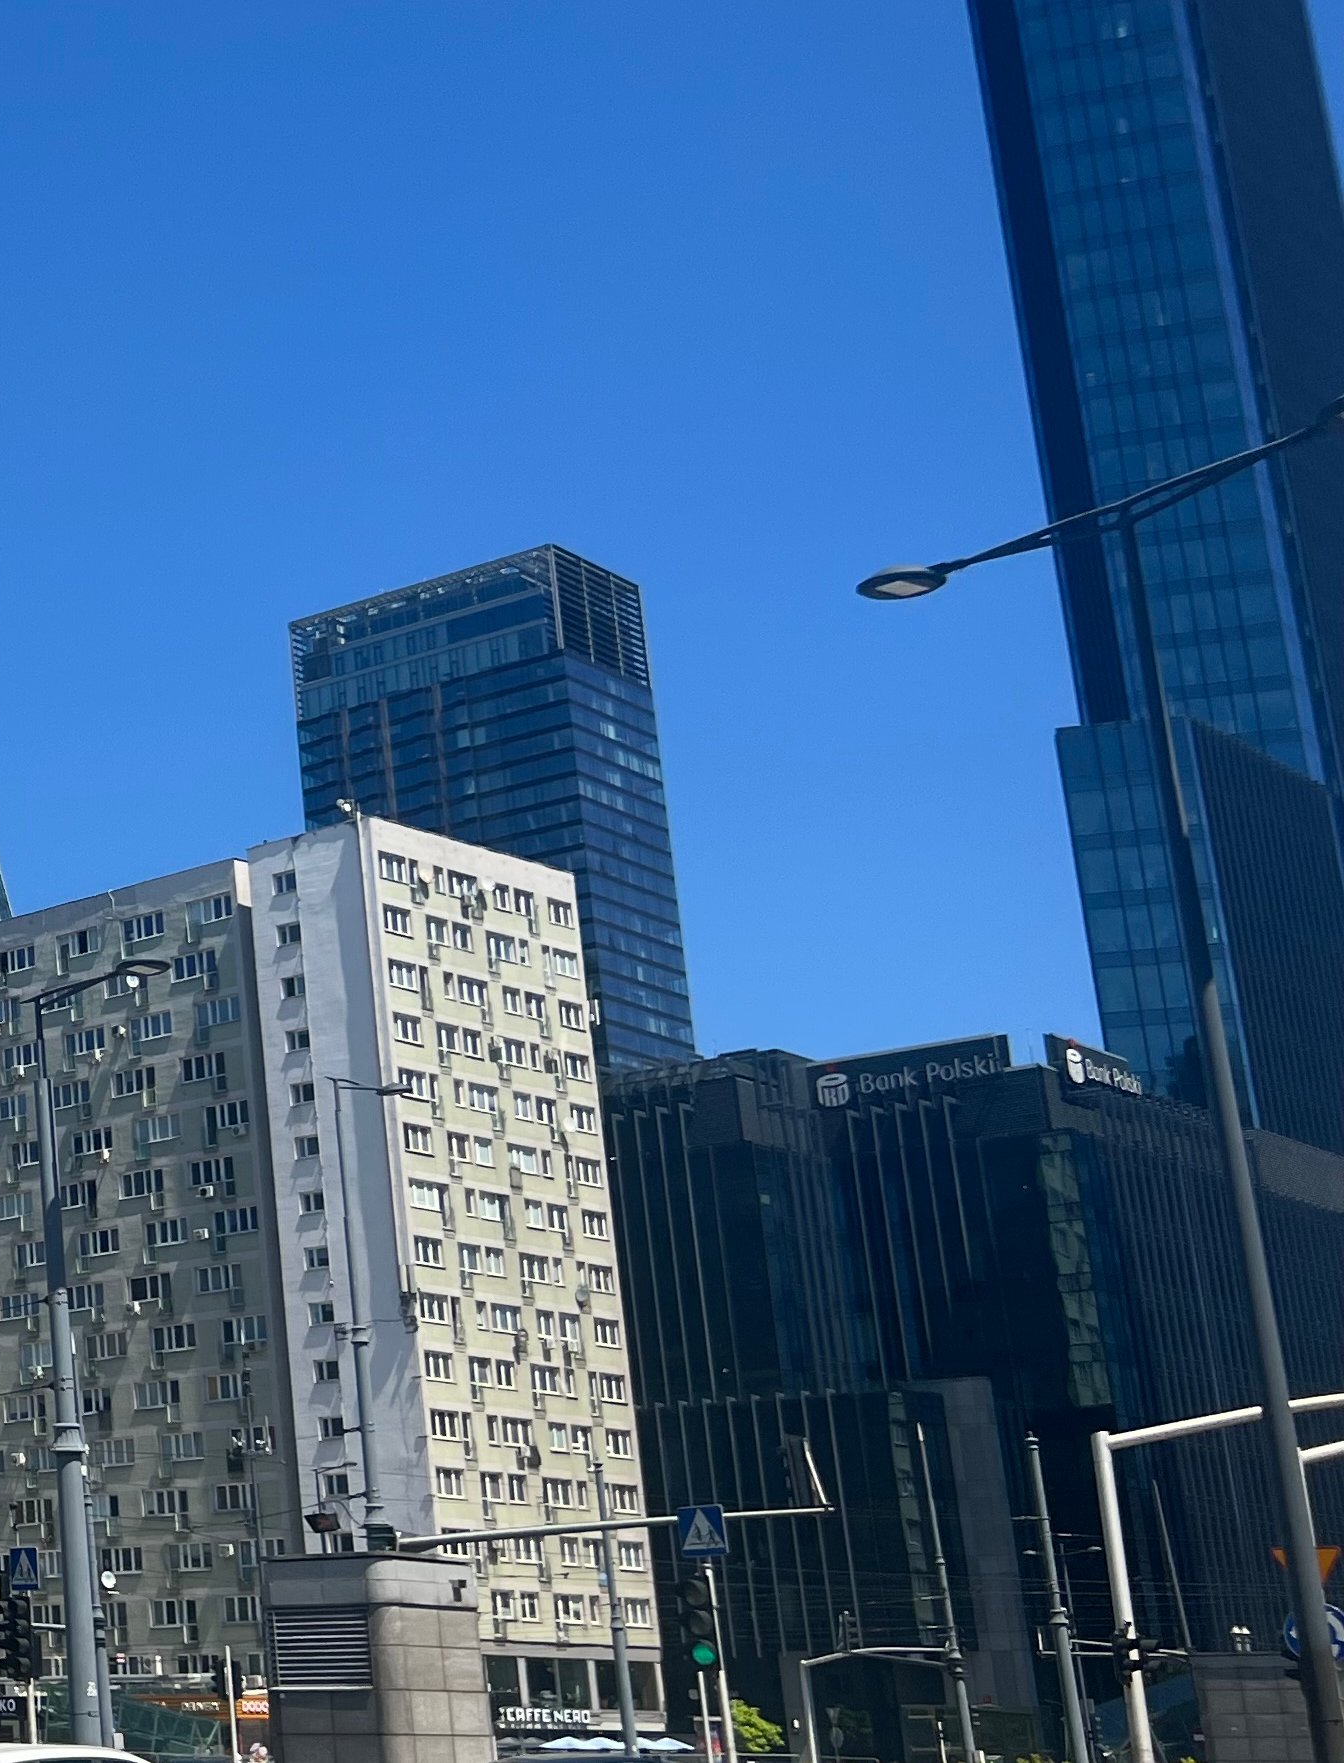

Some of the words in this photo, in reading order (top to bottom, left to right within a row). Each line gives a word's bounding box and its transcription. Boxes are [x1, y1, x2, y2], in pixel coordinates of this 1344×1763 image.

[859, 1066, 919, 1094] Bank
[925, 1053, 1000, 1082] Polski
[1085, 1058, 1112, 1086] Bank
[552, 1709, 591, 1724] NERO
